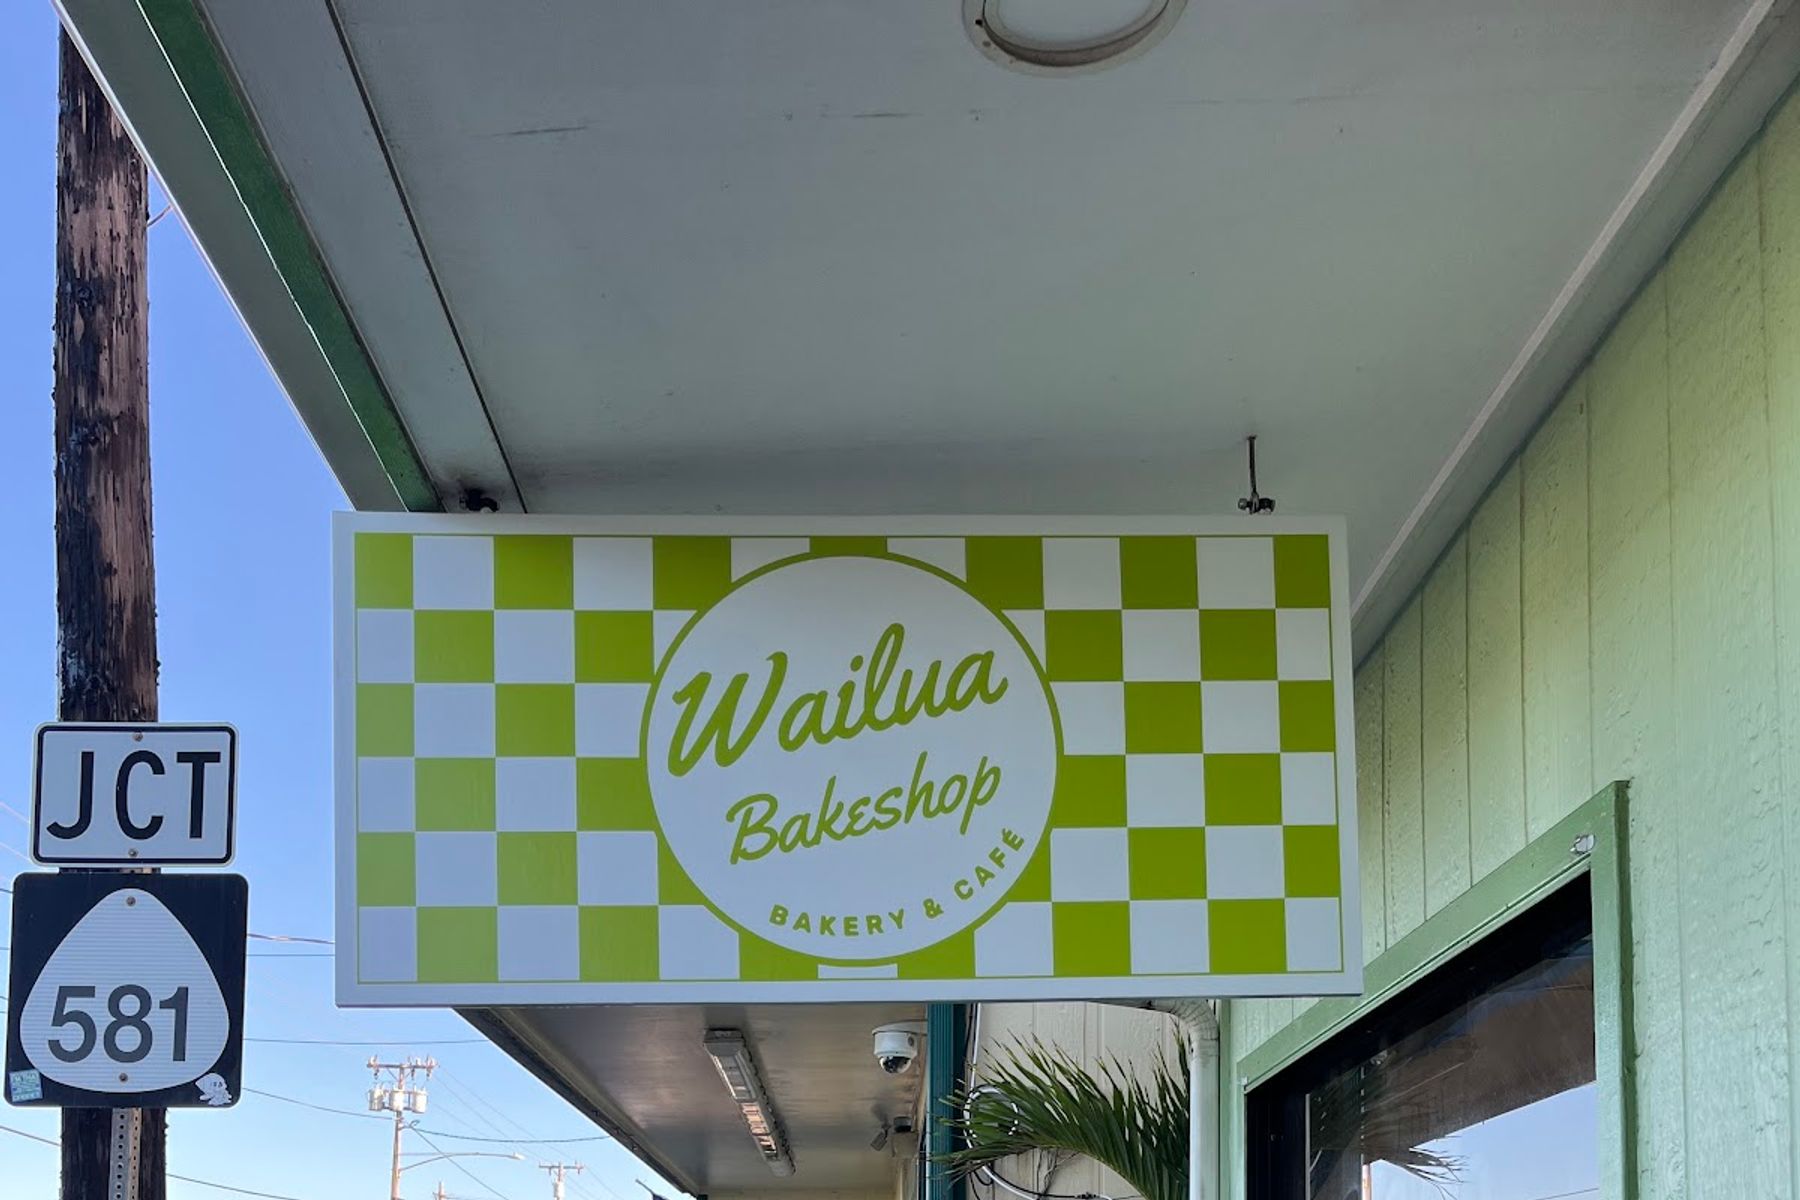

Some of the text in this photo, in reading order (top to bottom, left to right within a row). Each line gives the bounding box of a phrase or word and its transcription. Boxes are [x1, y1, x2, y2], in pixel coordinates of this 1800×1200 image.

[667, 622, 1009, 778] Wailua
[46, 750, 221, 840] JCT
[725, 750, 1002, 866] Bakeshop
[768, 904, 906, 937] BAKERY
[922, 898, 945, 919] &
[47, 983, 190, 1064] 581
